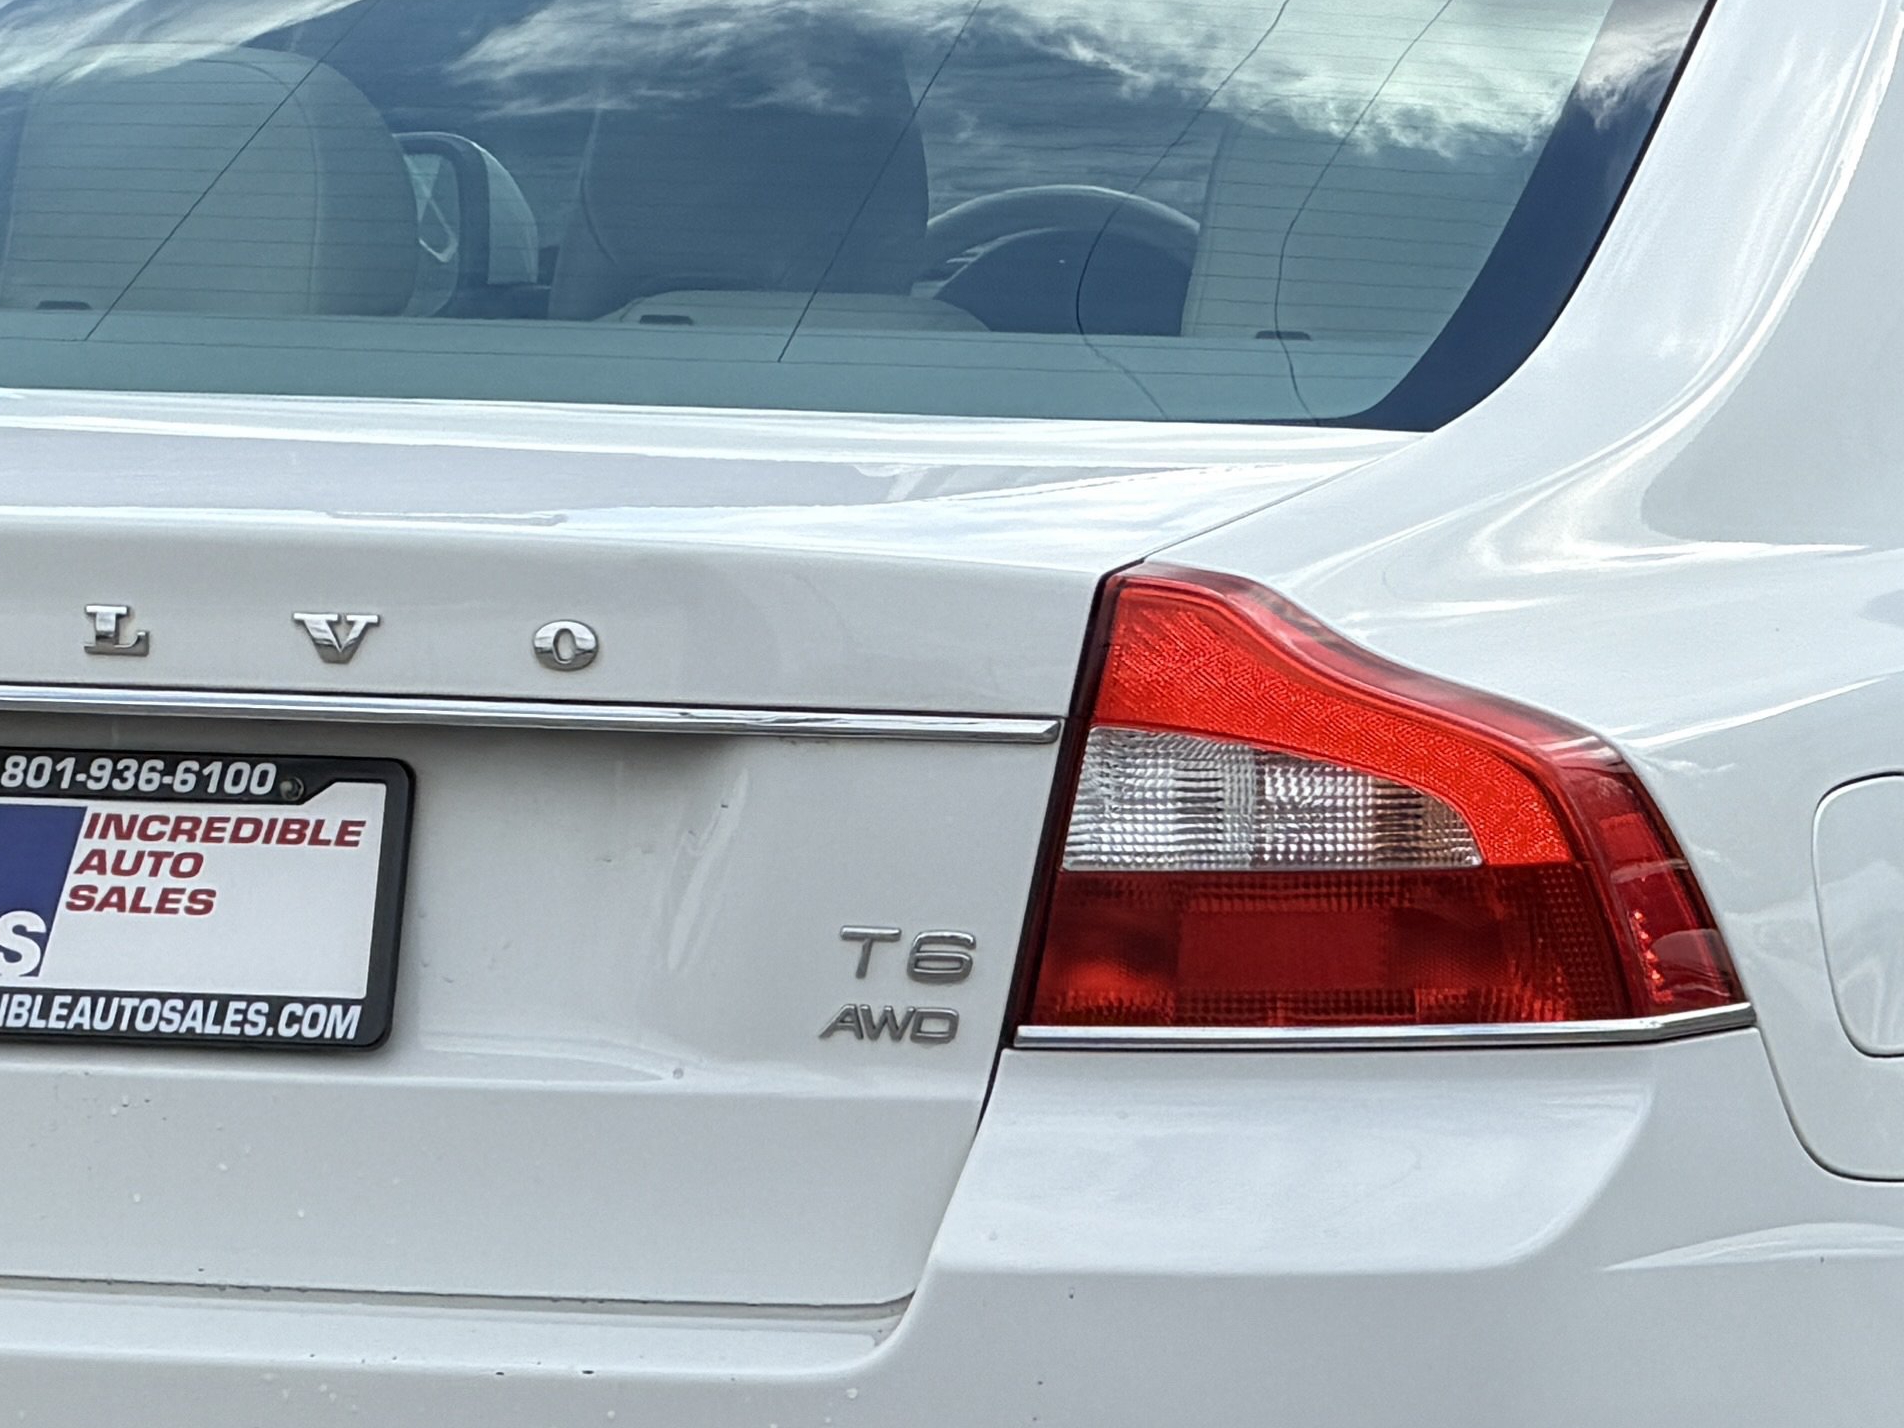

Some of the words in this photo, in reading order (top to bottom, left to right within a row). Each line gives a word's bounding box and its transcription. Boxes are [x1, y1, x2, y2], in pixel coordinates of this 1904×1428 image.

[0, 755, 278, 796] 801-936-6100
[82, 812, 367, 848] INCREDIBLE
[73, 849, 205, 879] AUTO
[65, 884, 217, 917] SALES
[839, 925, 977, 984] T6
[816, 1003, 960, 1045] AWD
